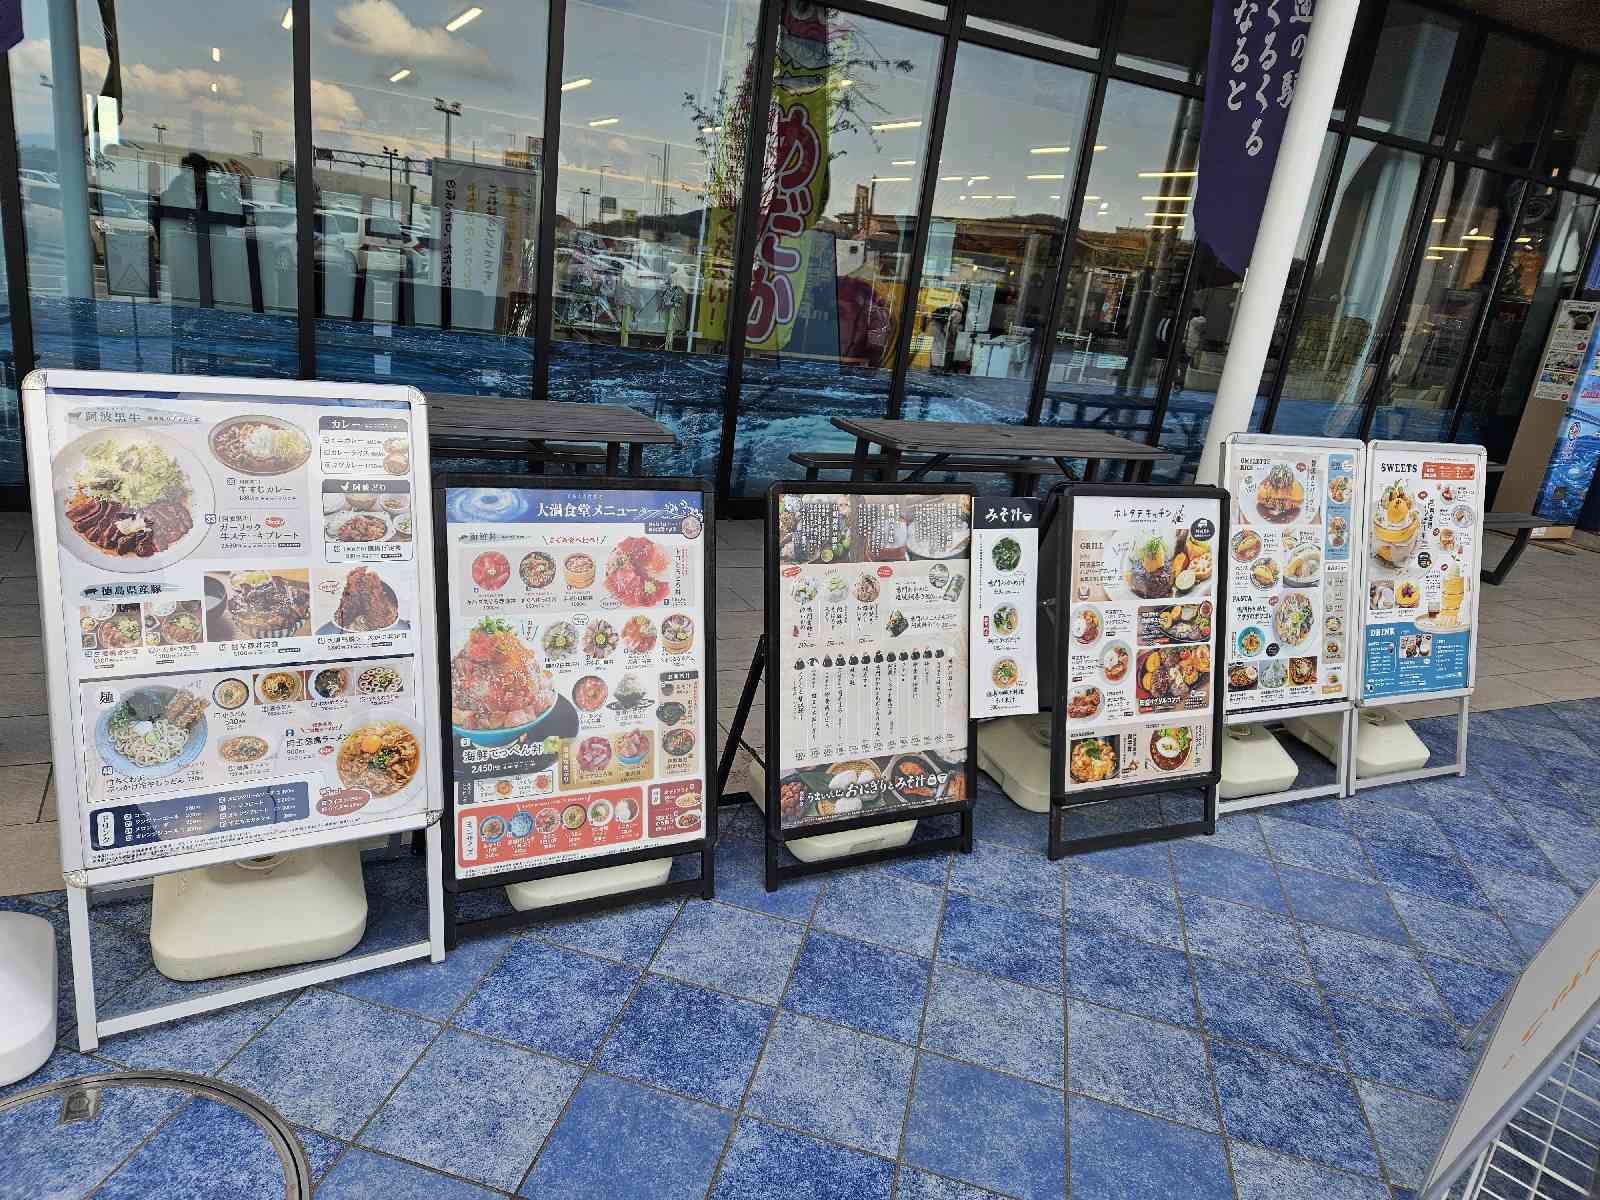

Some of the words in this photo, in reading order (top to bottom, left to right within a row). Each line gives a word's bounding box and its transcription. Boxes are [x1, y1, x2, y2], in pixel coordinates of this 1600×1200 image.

[330, 419, 361, 429] カレー
[1380, 463, 1418, 473] SWEETS
[537, 502, 638, 518] 大渦食堂メニュー
[984, 507, 1023, 523] みそ汁
[1079, 542, 1105, 550] GRILL
[1232, 595, 1253, 603] PASTA
[1369, 627, 1396, 637] DRINK
[99, 691, 115, 705] 麺
[462, 742, 545, 764] 海鮮てっぺん丼
